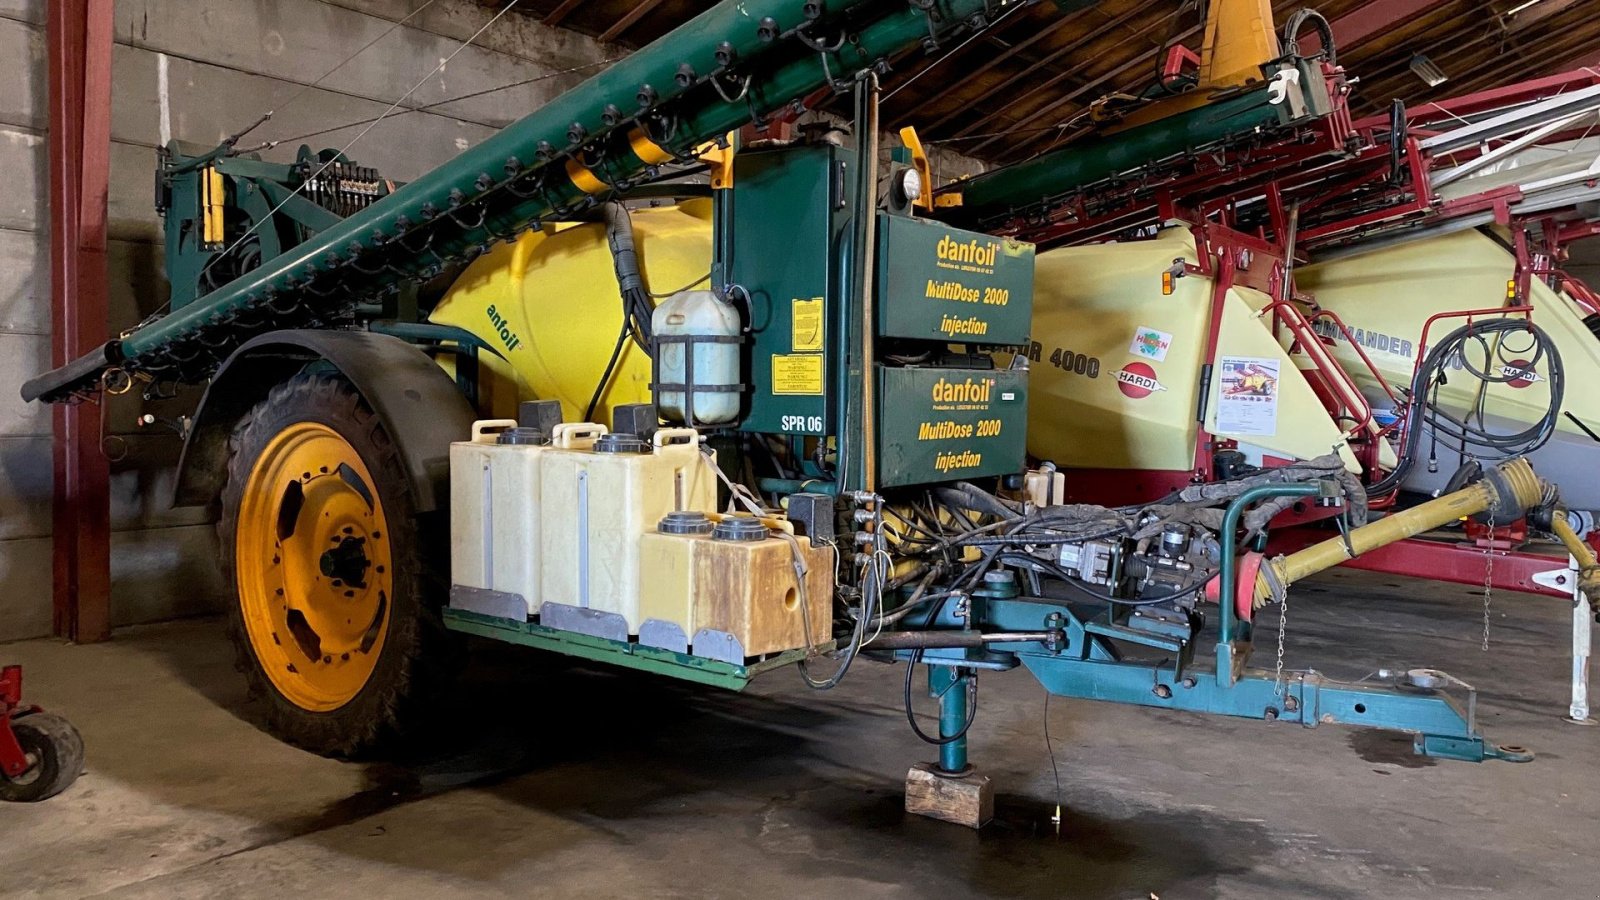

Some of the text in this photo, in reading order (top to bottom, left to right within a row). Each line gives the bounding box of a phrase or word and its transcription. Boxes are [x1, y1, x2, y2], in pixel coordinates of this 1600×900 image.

[937, 235, 996, 266] danfoil
[925, 280, 1009, 306] MultiDose 2000
[487, 304, 520, 351] anfoil
[941, 314, 988, 337] injection
[1311, 318, 1413, 358] OMMANDER
[1050, 347, 1100, 379] 4000
[1503, 367, 1536, 381] HADI
[932, 378, 990, 402] danfoil
[1119, 371, 1156, 389] HARDI
[781, 415, 822, 432] SPR 06
[918, 420, 1002, 440] MultiDose 2000
[935, 450, 981, 473] injection
